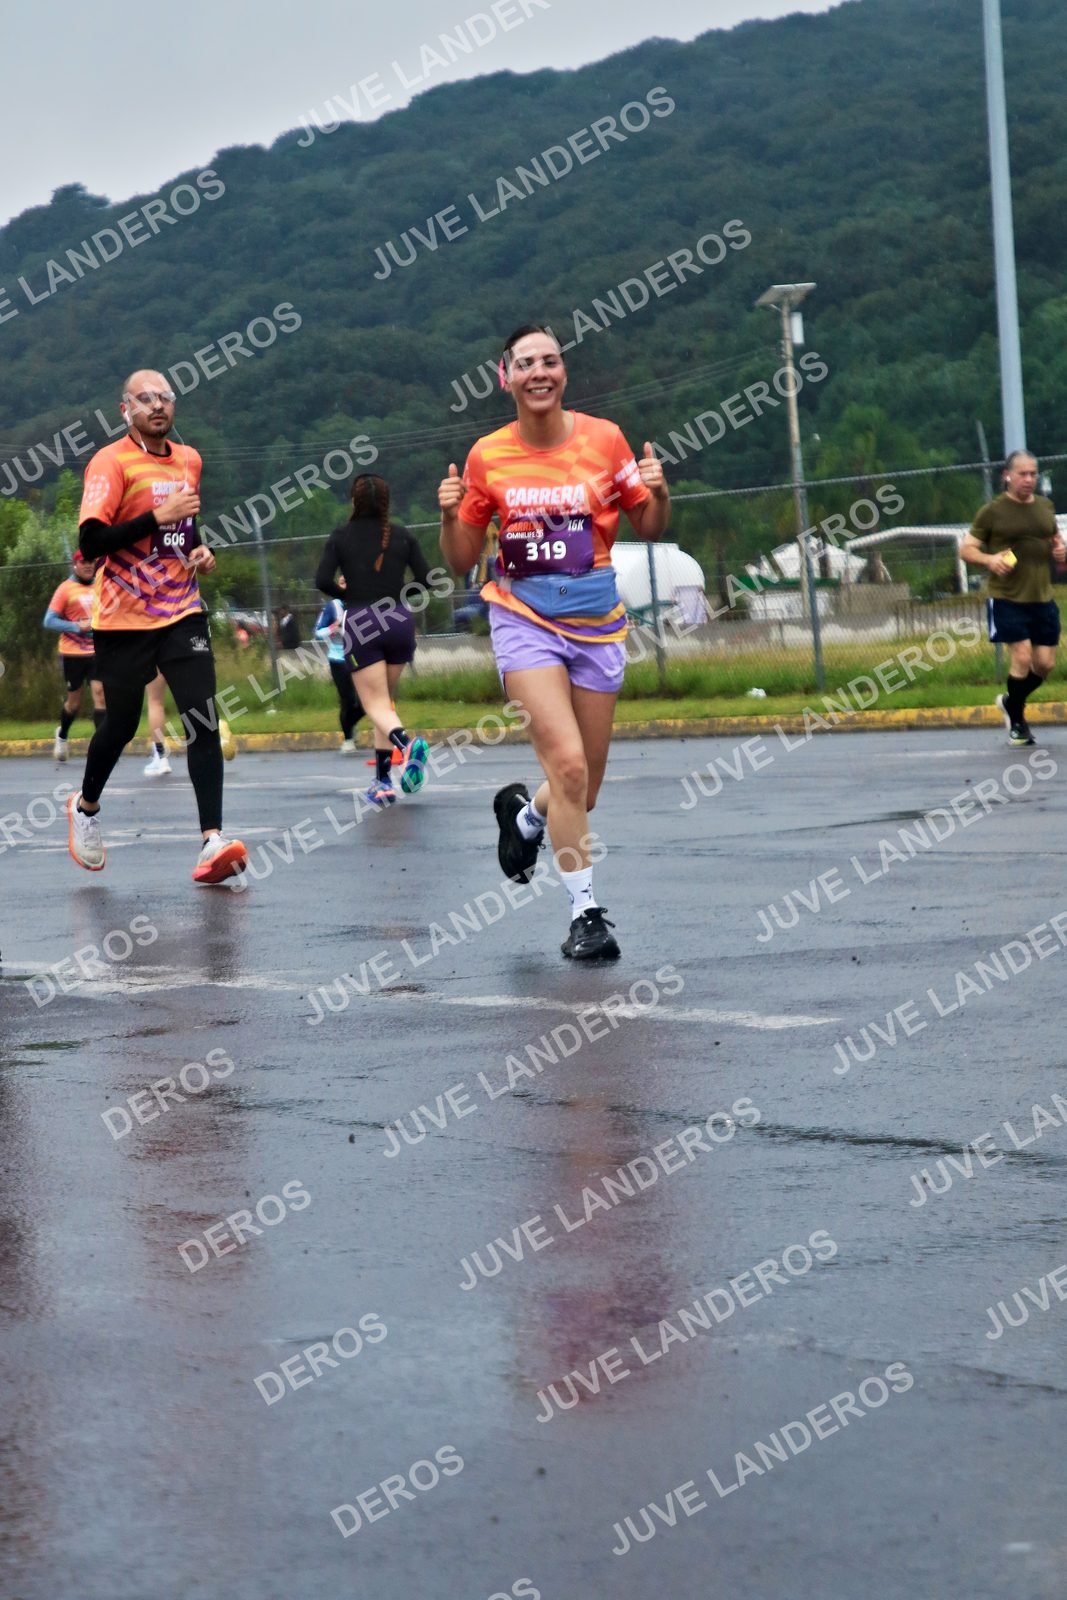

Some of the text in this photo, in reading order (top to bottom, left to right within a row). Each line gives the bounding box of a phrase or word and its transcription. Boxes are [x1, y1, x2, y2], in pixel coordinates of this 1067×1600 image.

[506, 483, 585, 507] CARRERA
[164, 533, 185, 546] 606
[506, 531, 535, 539] OMNILIFE
[526, 540, 566, 561] 319
